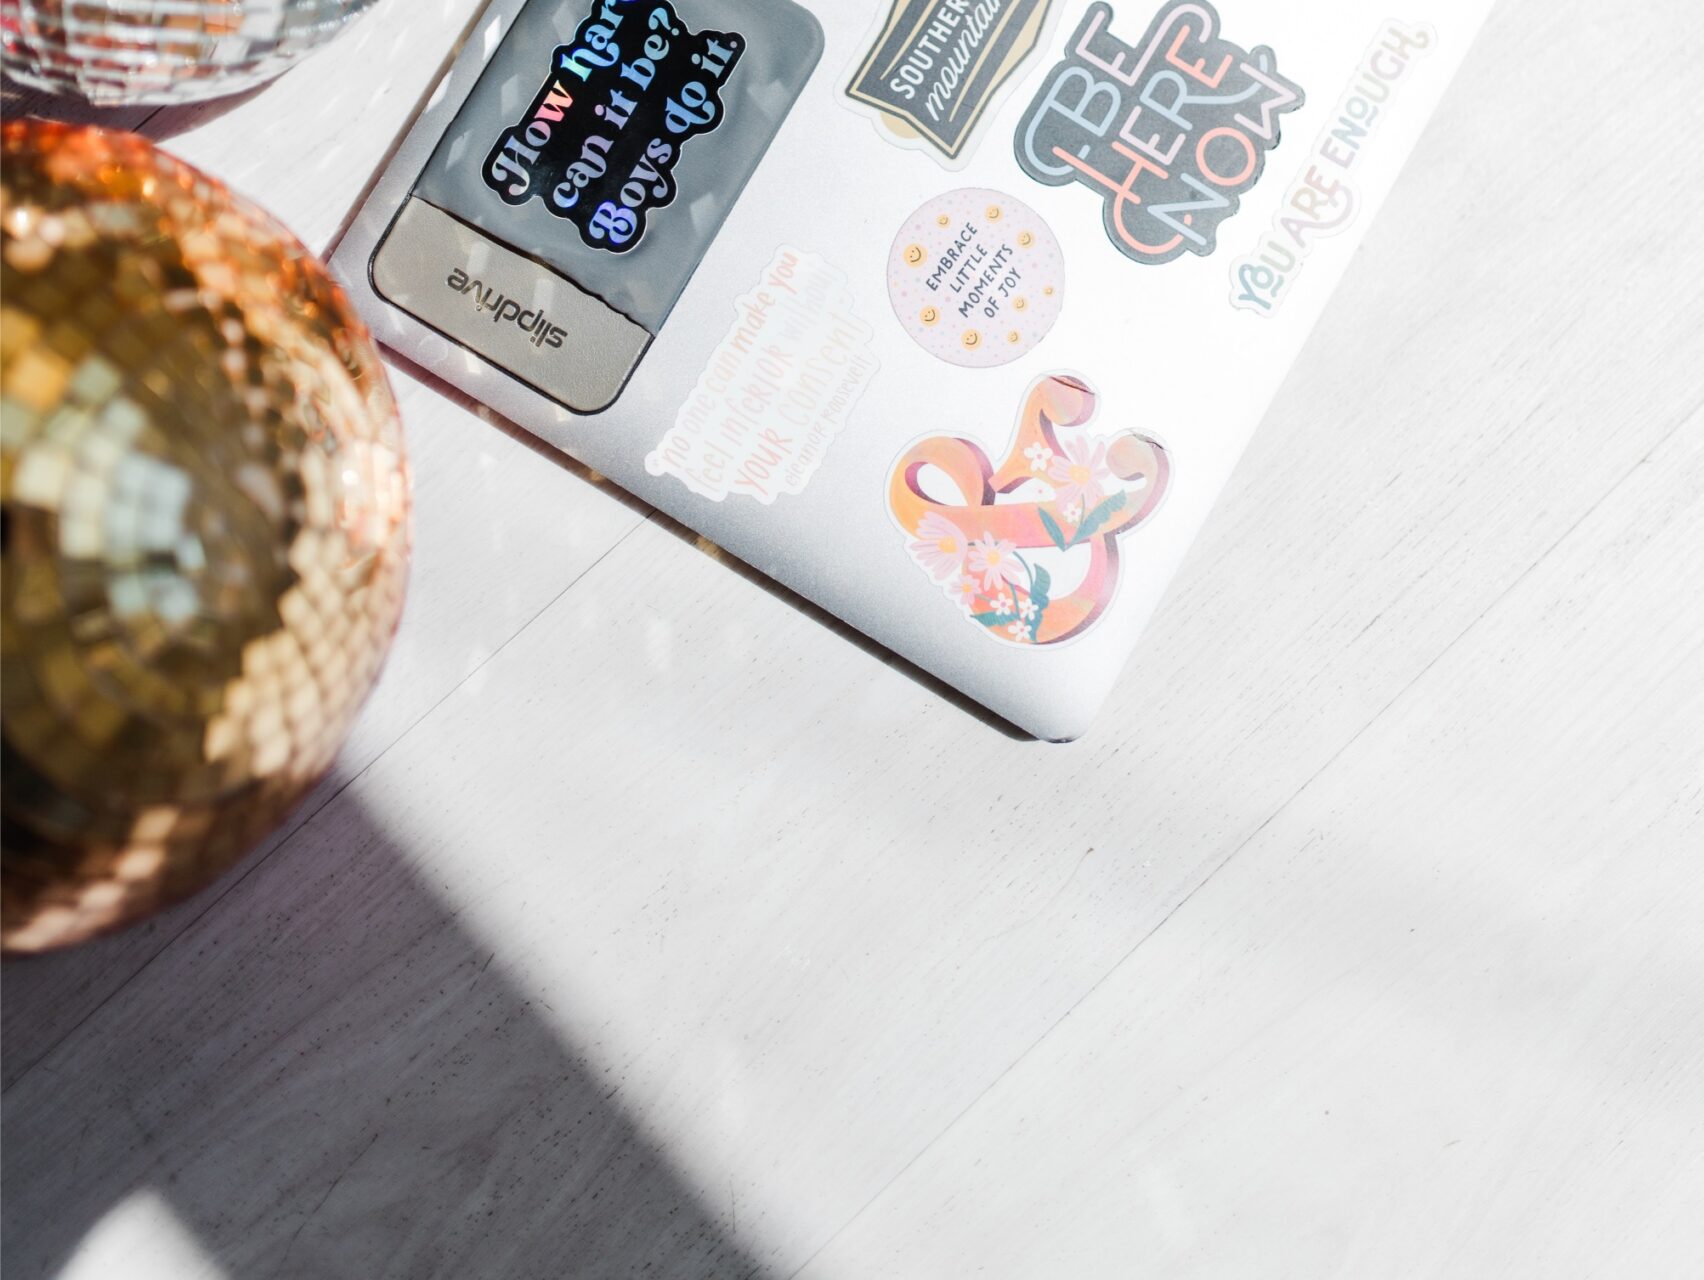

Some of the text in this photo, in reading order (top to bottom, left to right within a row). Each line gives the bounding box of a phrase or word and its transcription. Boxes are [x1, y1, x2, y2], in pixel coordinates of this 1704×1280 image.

[491, 80, 573, 196] How
[553, 7, 680, 208] can it be?
[589, 137, 672, 244] Boys
[665, 81, 716, 133] do
[1024, 3, 1213, 177] BE
[1052, 24, 1268, 254] HERE
[1147, 62, 1297, 246] NOW
[1238, 26, 1429, 310] YOU ARE ENOUGH
[446, 267, 568, 349] slipdrive
[925, 222, 977, 292] EMBRACE
[949, 243, 988, 293] LITTLE
[958, 243, 1014, 318] MOMENTS
[983, 267, 1021, 318] OF JOY
[661, 251, 800, 469] no one can make you
